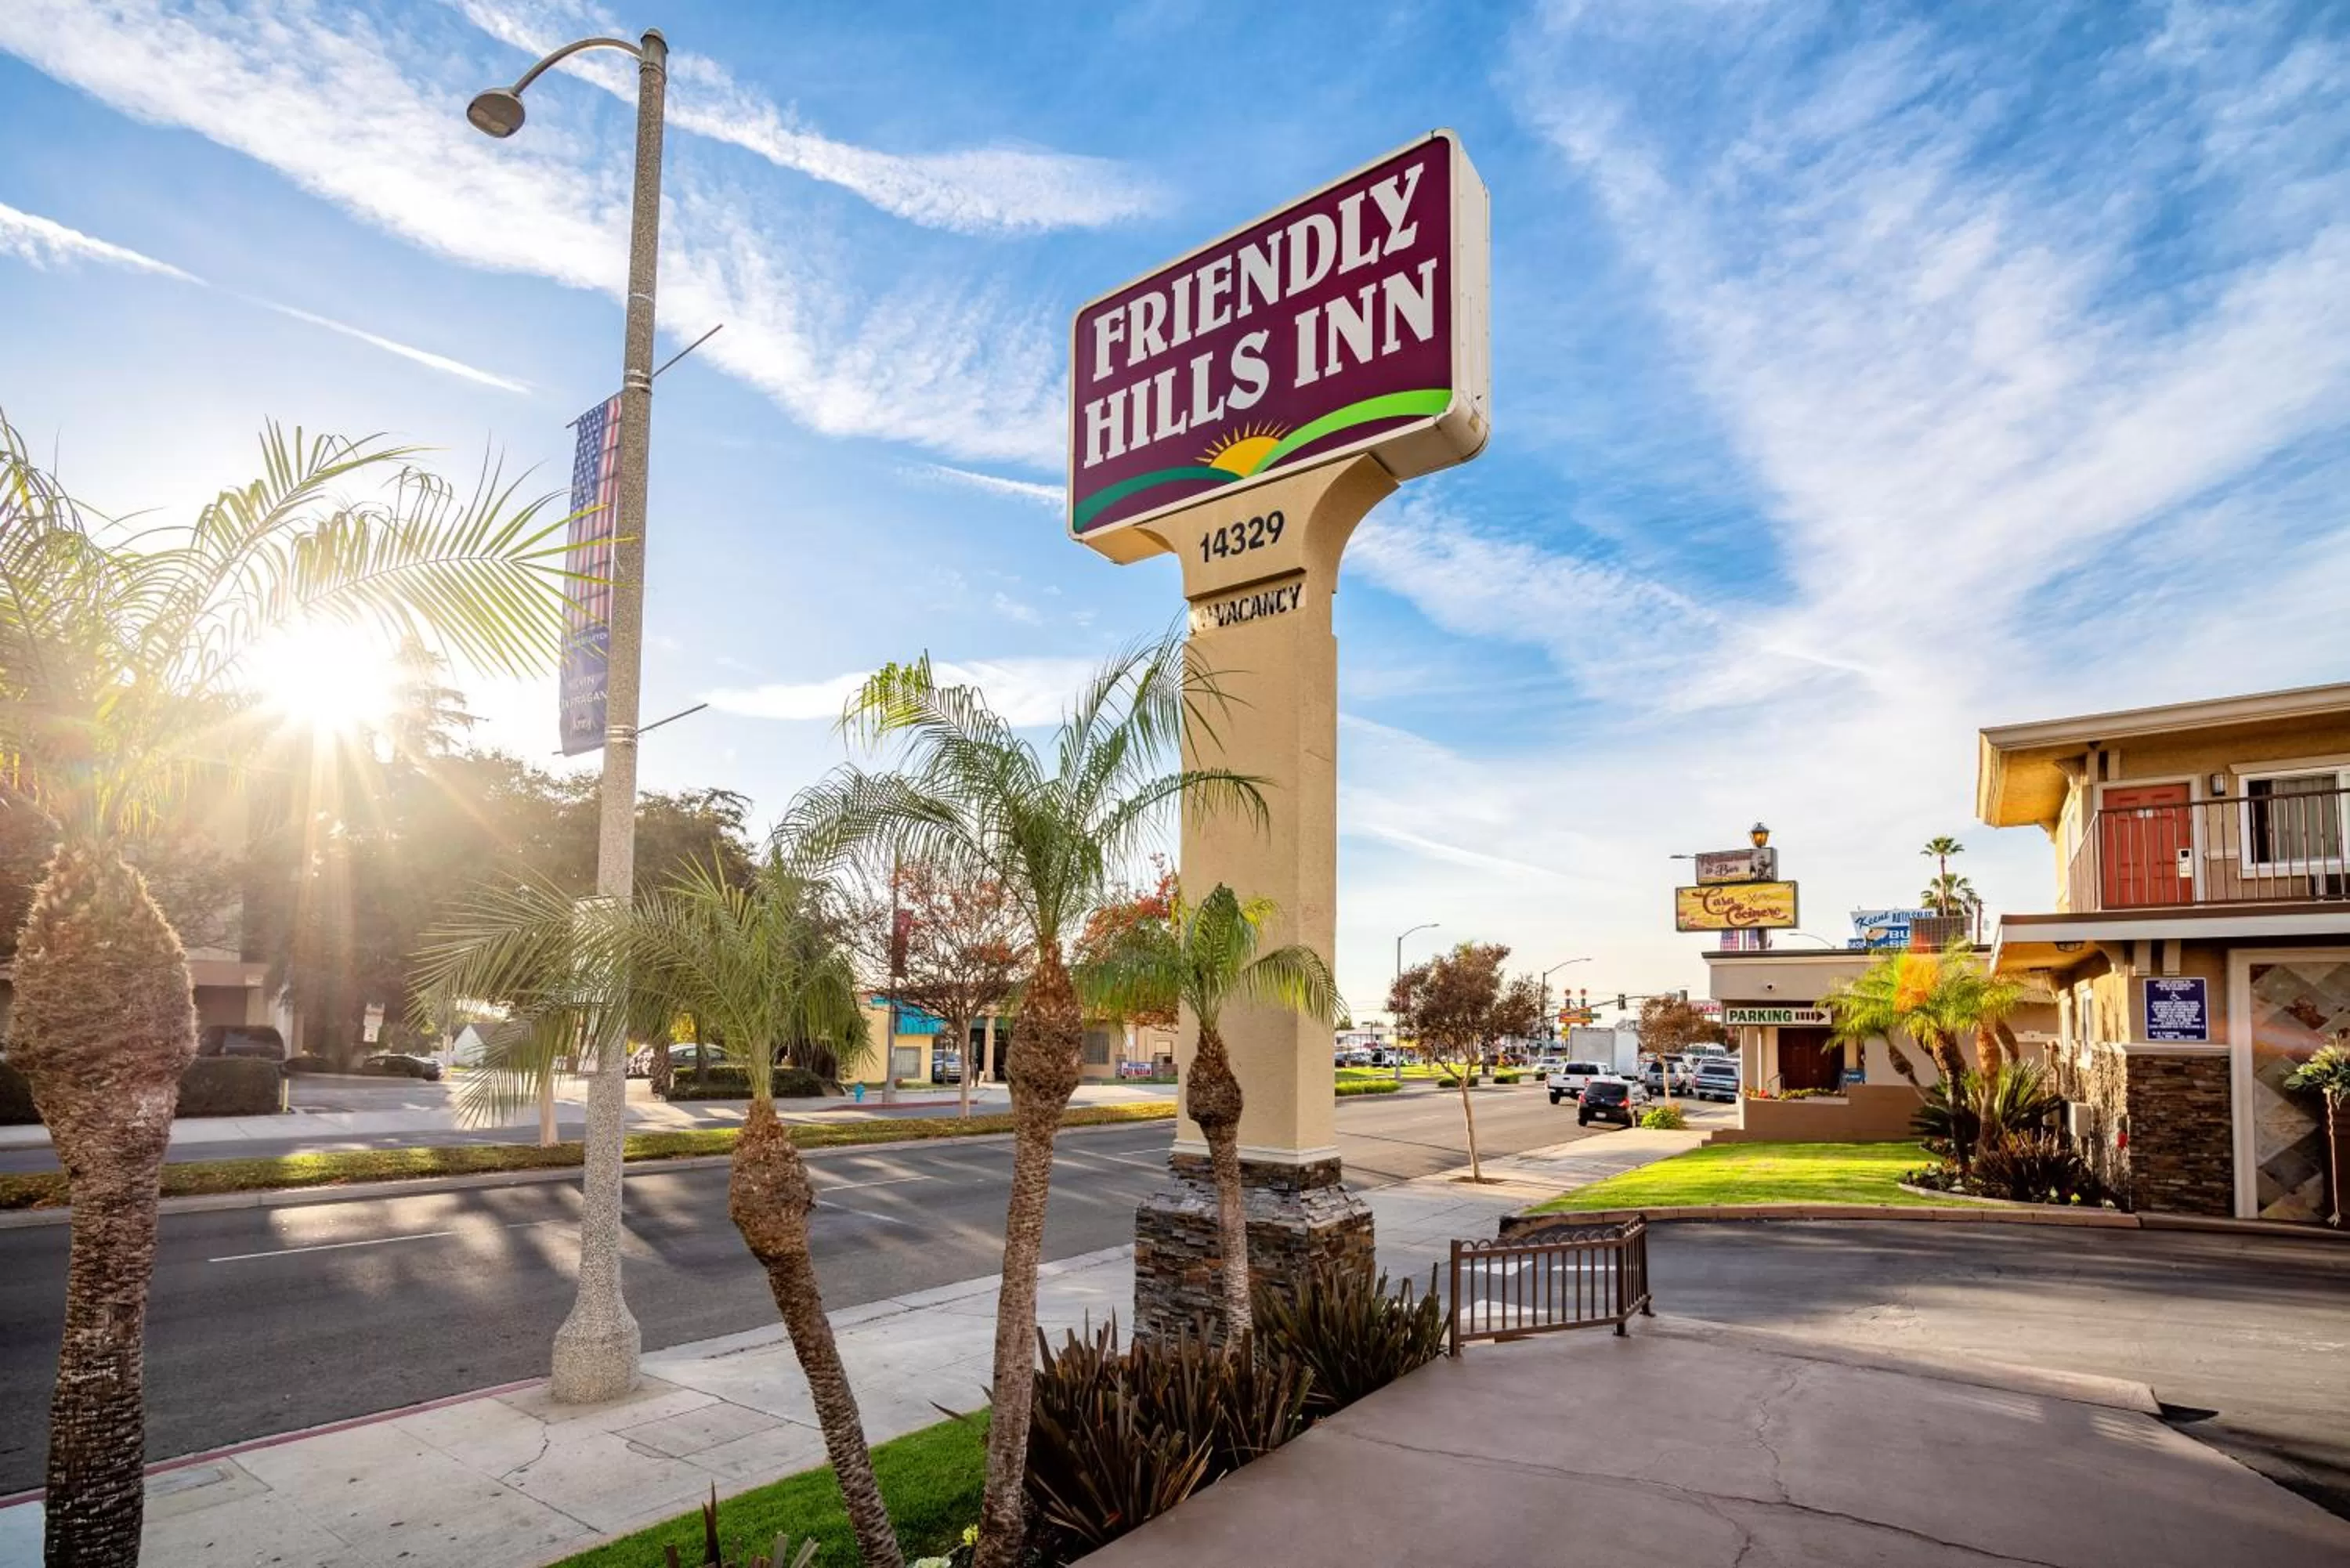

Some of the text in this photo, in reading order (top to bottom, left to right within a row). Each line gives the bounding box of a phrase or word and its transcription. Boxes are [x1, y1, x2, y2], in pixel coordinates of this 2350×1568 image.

[1093, 162, 1424, 382] FRIENDLY
[1083, 258, 1437, 470] HILLS INN
[1200, 511, 1285, 563] 14329
[1215, 583, 1303, 627] VACANCY
[1692, 887, 1734, 915] Casa
[1729, 1010, 1793, 1022] PARKING
